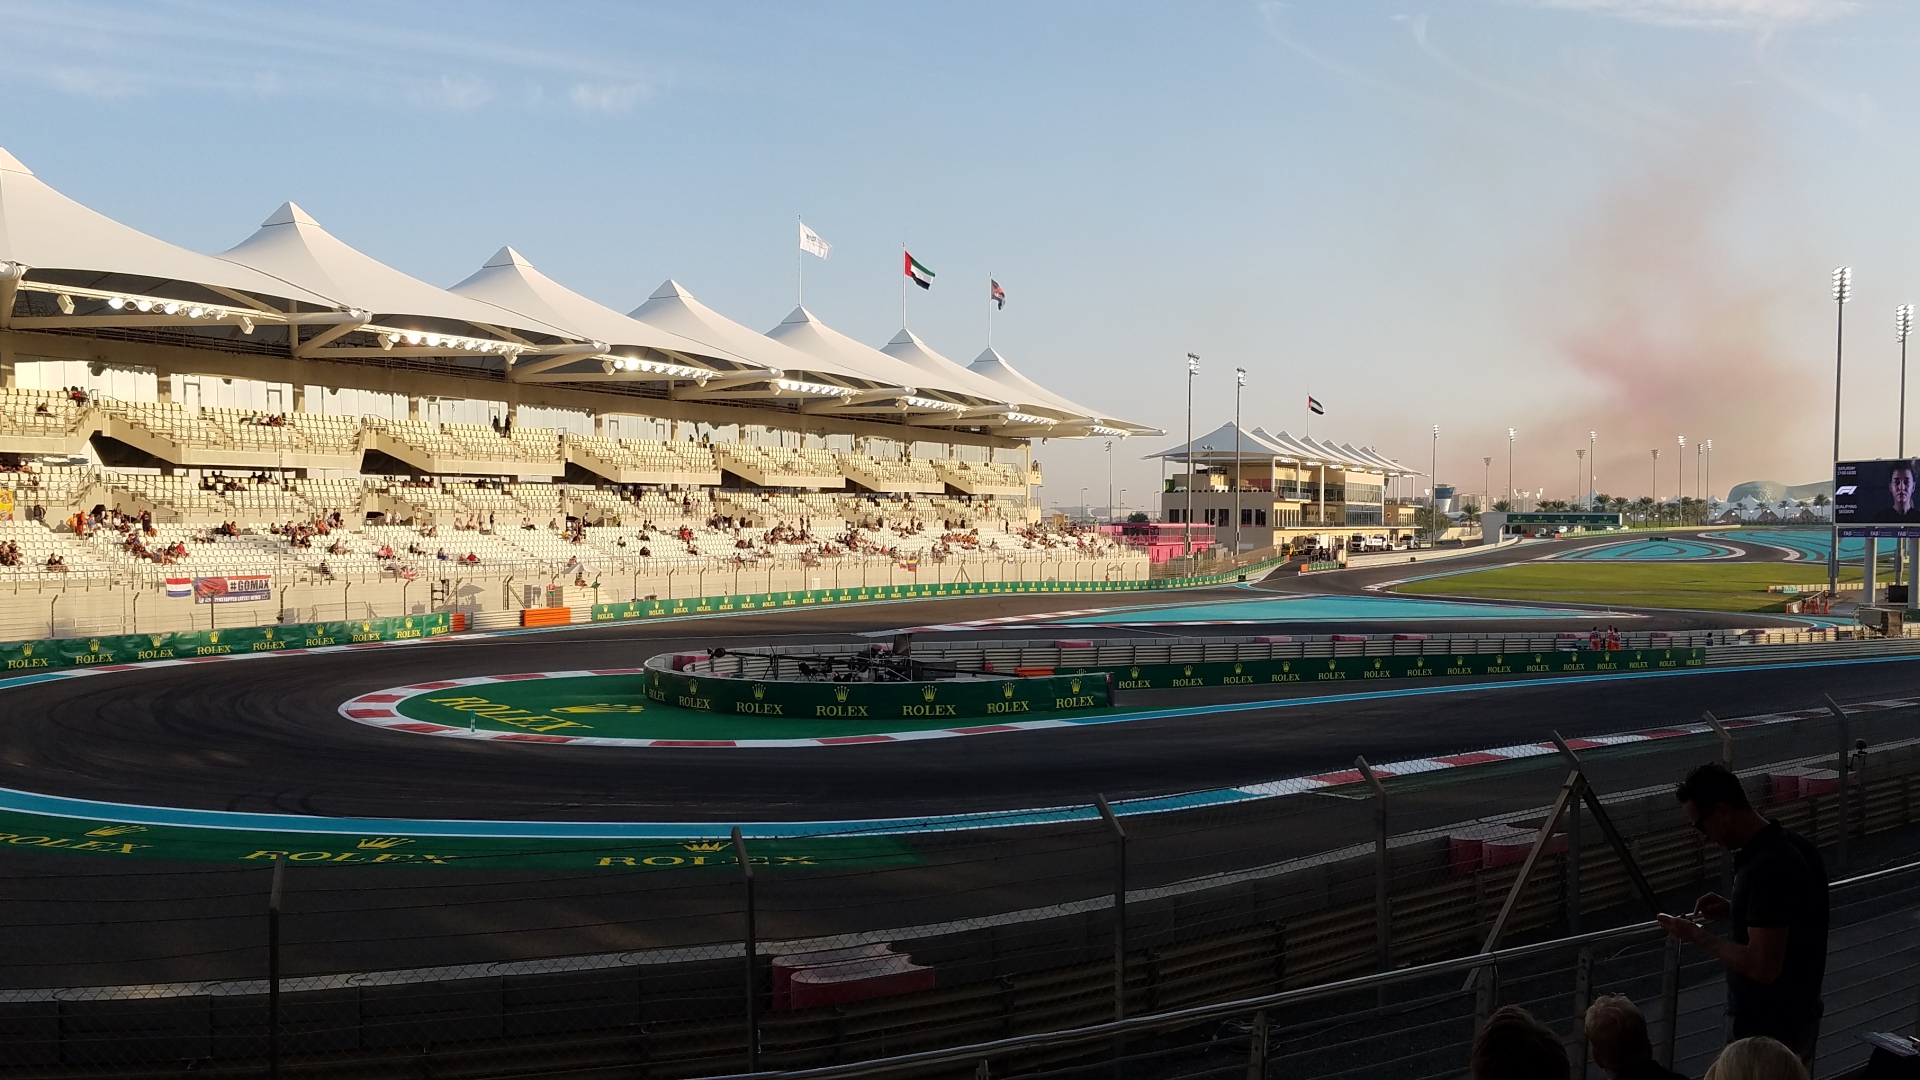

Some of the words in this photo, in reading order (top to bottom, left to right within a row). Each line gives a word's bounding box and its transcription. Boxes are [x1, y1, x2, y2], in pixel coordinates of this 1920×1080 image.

[1836, 486, 1857, 495] F1
[230, 580, 270, 591] #GOMAX
[396, 629, 421, 639] ROLEX
[432, 625, 448, 635] ROLEX
[306, 637, 335, 647] ROLEX
[352, 632, 381, 642] ROLEX
[197, 645, 231, 655] ROLEX
[252, 641, 286, 650] ROLEX
[75, 654, 114, 664] ROLEX
[138, 649, 174, 659] ROLEX
[8, 658, 49, 669] ROLEX
[1526, 664, 1550, 672] ROLEX
[1597, 662, 1617, 670] ROLEX
[1318, 671, 1346, 680] ROLEX
[1364, 670, 1390, 678] ROLEX
[1407, 669, 1432, 677] ROLEX
[1447, 667, 1472, 675] ROLEX
[1172, 678, 1204, 687] ROLEX
[1223, 676, 1254, 684] ROLEX
[1272, 674, 1300, 682] ROLEX
[1119, 680, 1151, 689] ROLEX
[649, 689, 665, 701] ROLEX
[679, 696, 710, 709] ROLEX
[987, 701, 1030, 713] ROLEX
[1056, 696, 1094, 708] ROLEX
[736, 702, 783, 715] ROLEX
[816, 706, 869, 716] ROLEX
[902, 705, 956, 716] ROLEX
[238, 850, 460, 865] ROLEX
